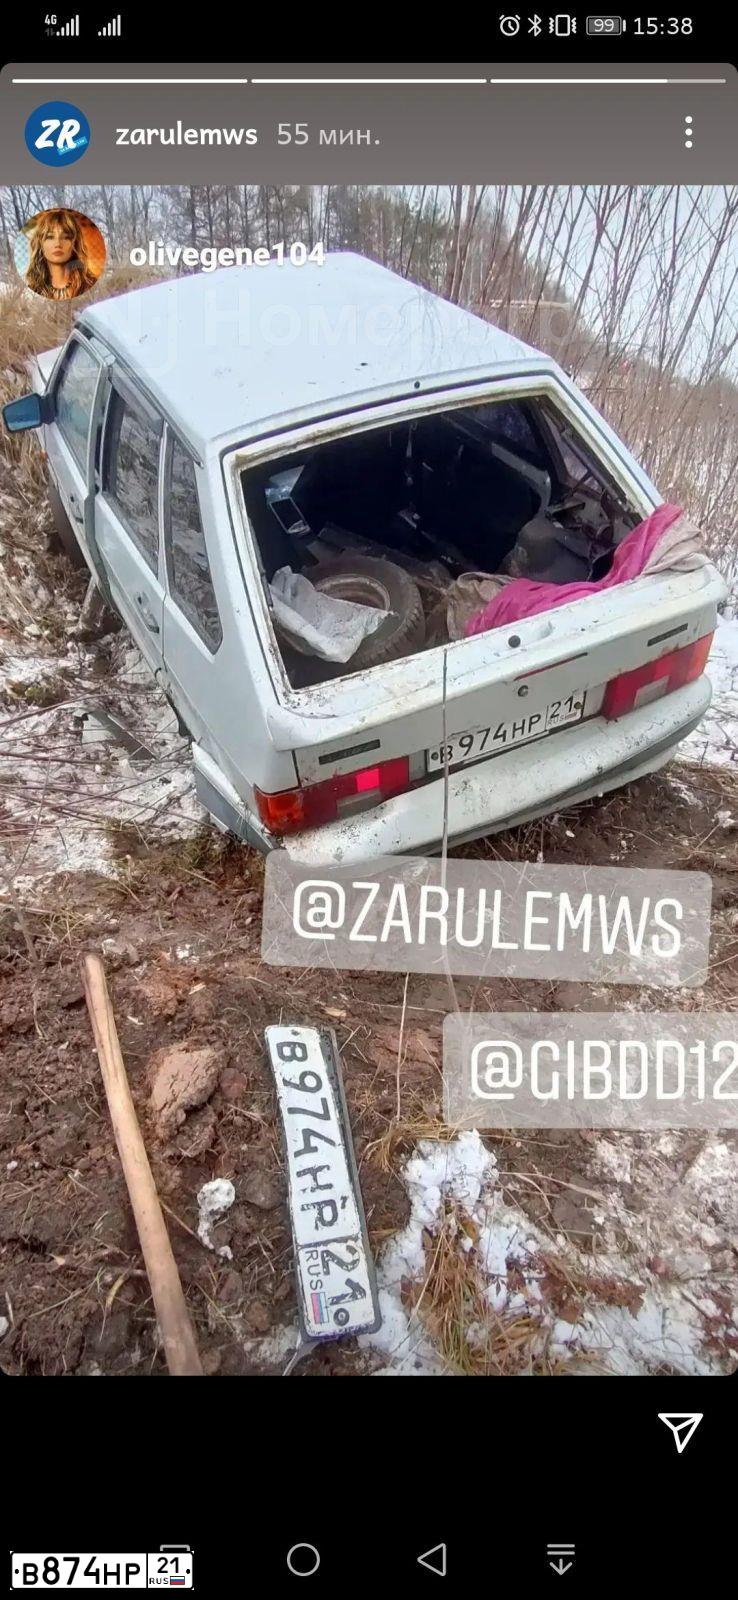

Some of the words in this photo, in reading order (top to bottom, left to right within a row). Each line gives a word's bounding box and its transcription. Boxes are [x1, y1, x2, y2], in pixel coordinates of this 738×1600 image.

[550, 695, 574, 720] 21
[305, 1249, 323, 1291] RUS
[321, 1244, 366, 1306] 21
